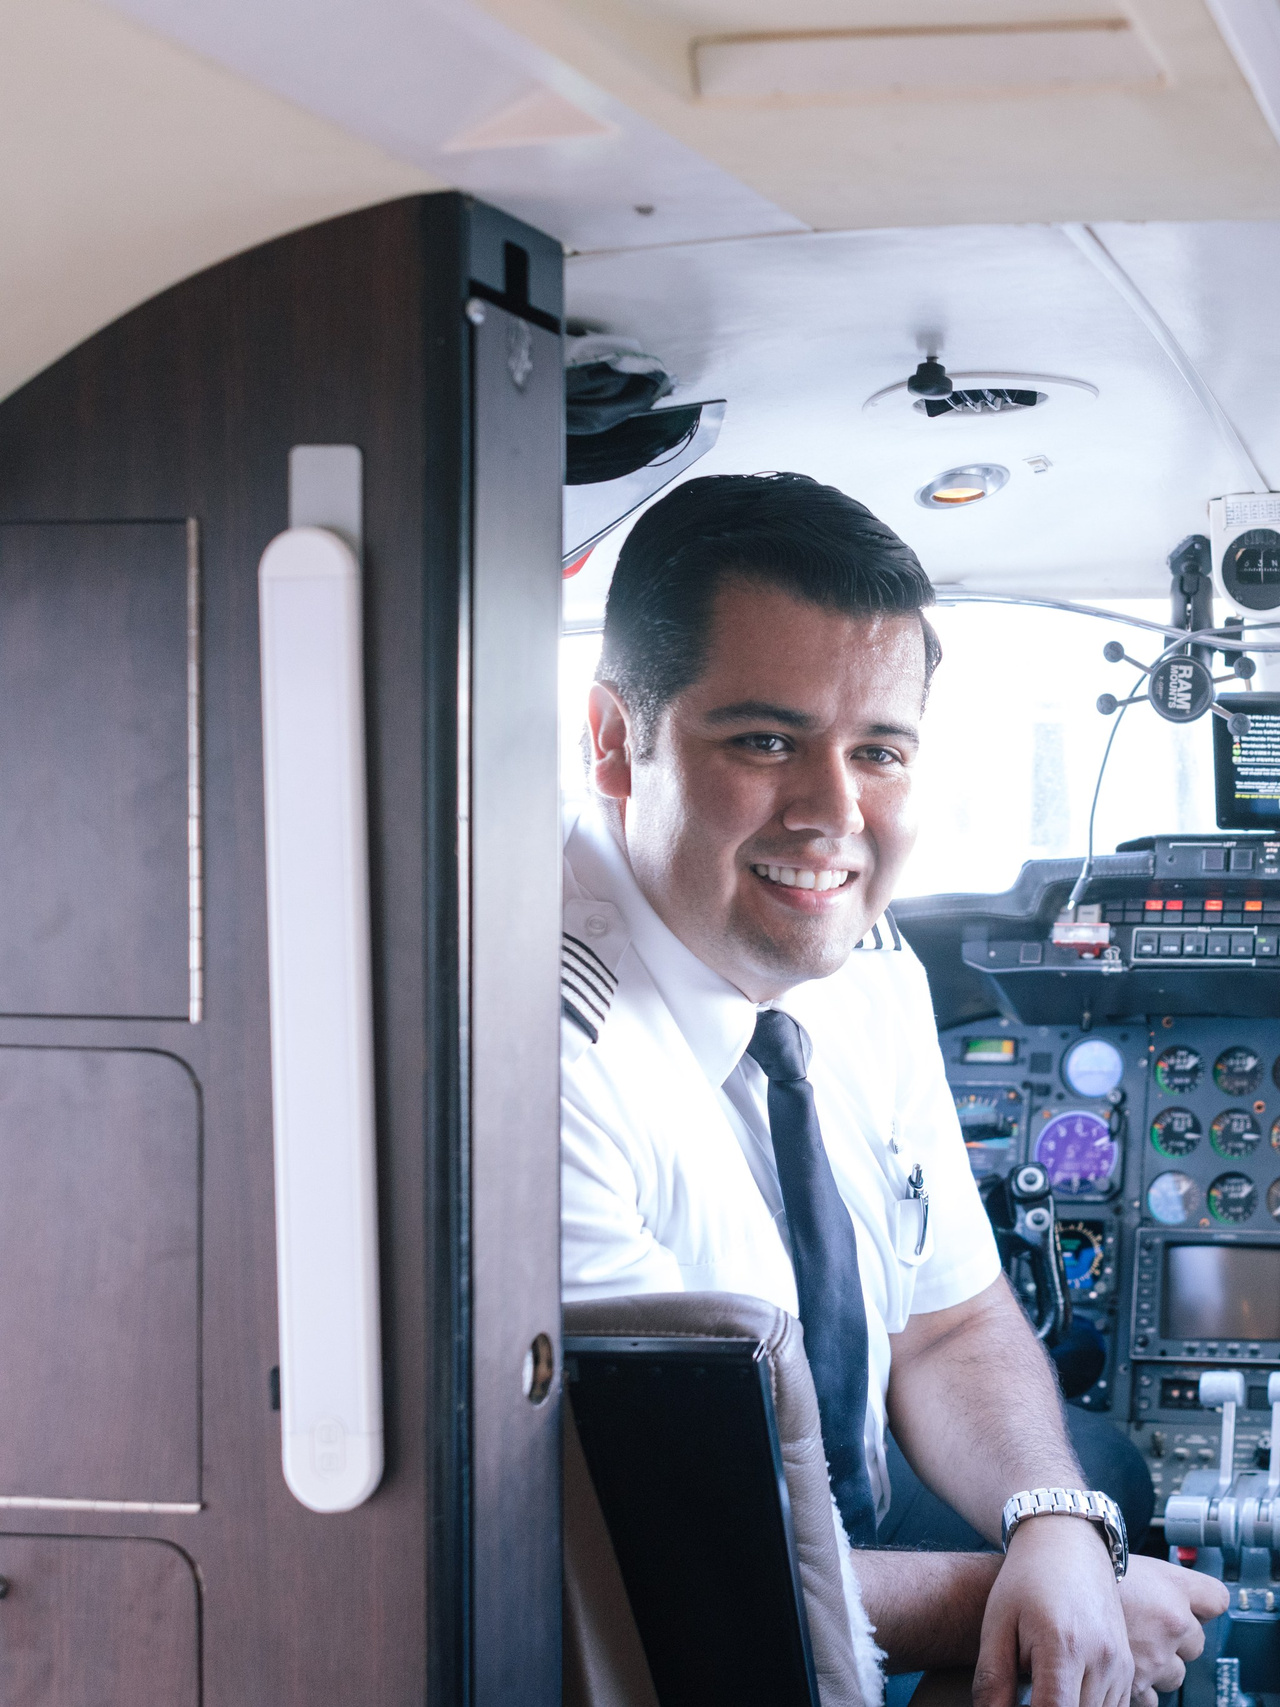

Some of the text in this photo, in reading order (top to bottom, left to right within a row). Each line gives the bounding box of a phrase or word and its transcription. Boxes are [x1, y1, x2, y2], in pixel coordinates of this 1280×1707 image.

[1271, 559, 1278, 567] N
[1168, 664, 1180, 709] MOUNTS
[1176, 664, 1194, 710] RAM
